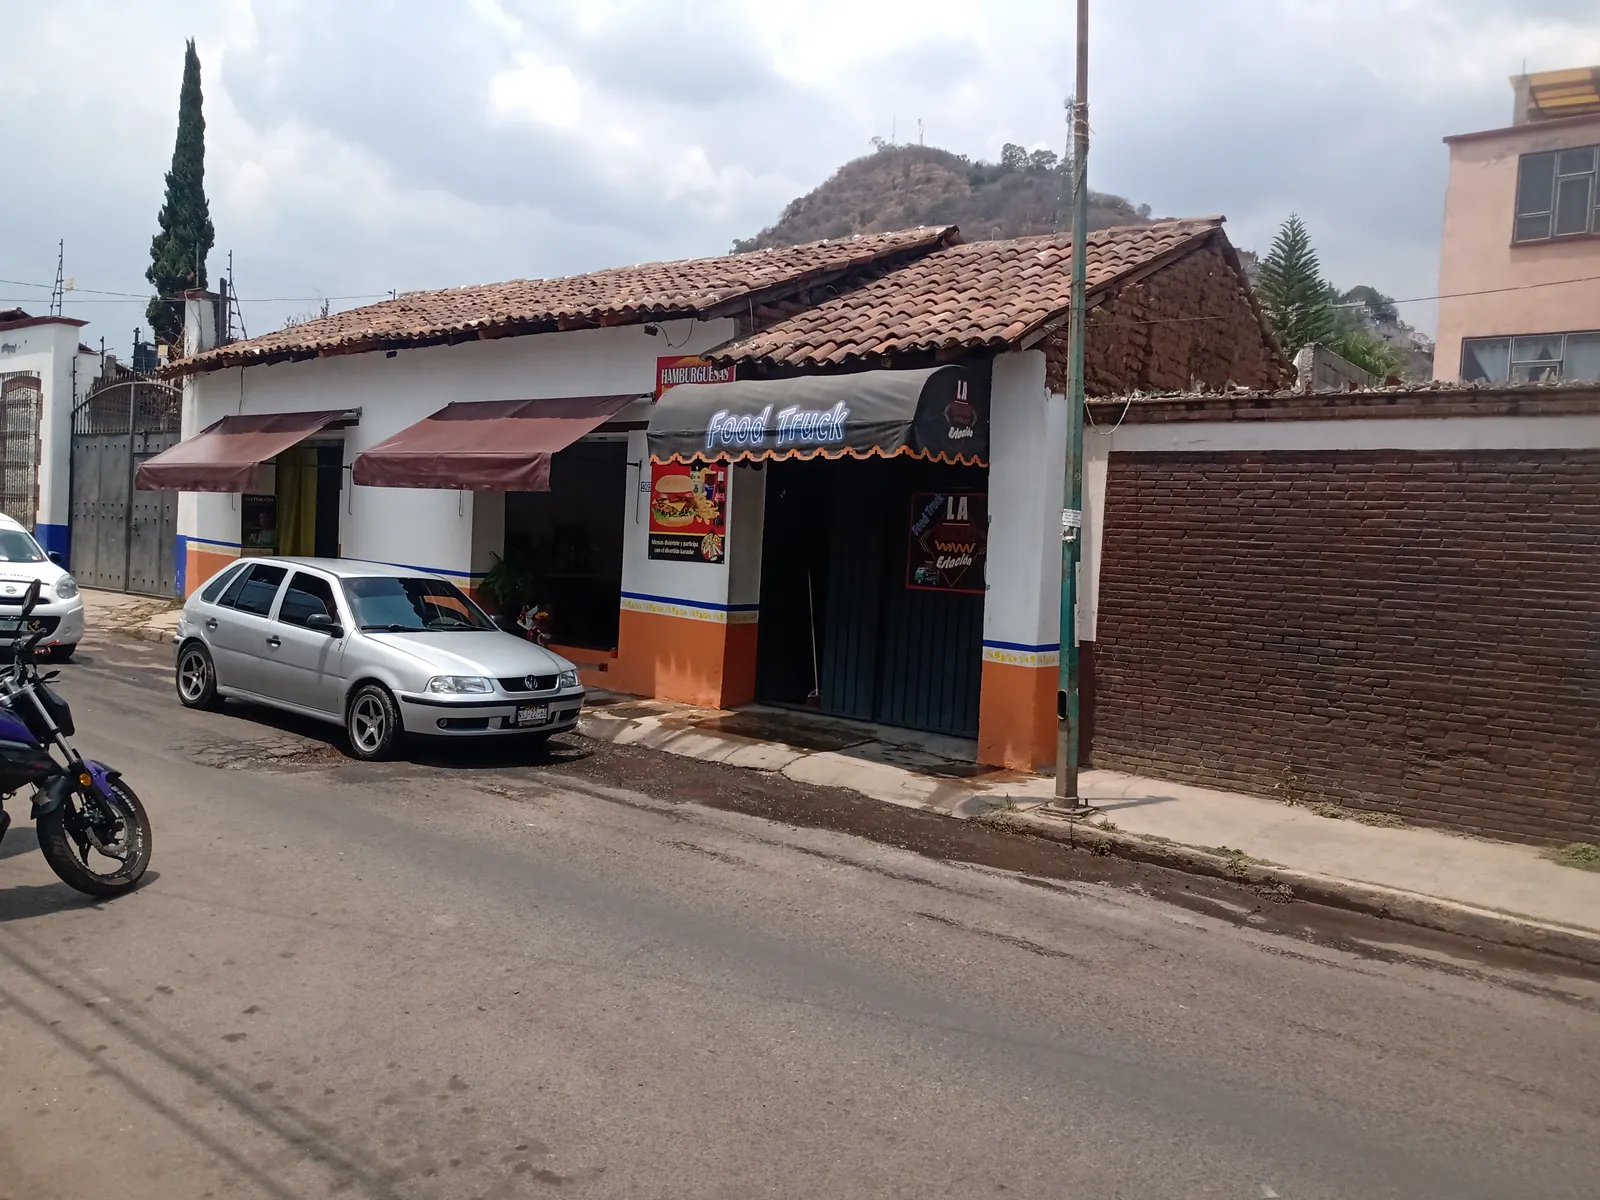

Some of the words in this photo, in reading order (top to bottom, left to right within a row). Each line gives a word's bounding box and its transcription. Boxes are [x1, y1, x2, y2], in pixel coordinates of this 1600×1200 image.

[661, 366, 730, 385] HAMBURGUESAS
[956, 380, 968, 400] LA
[706, 405, 774, 450] Food
[776, 401, 848, 446] Truck
[946, 496, 968, 520] LA
